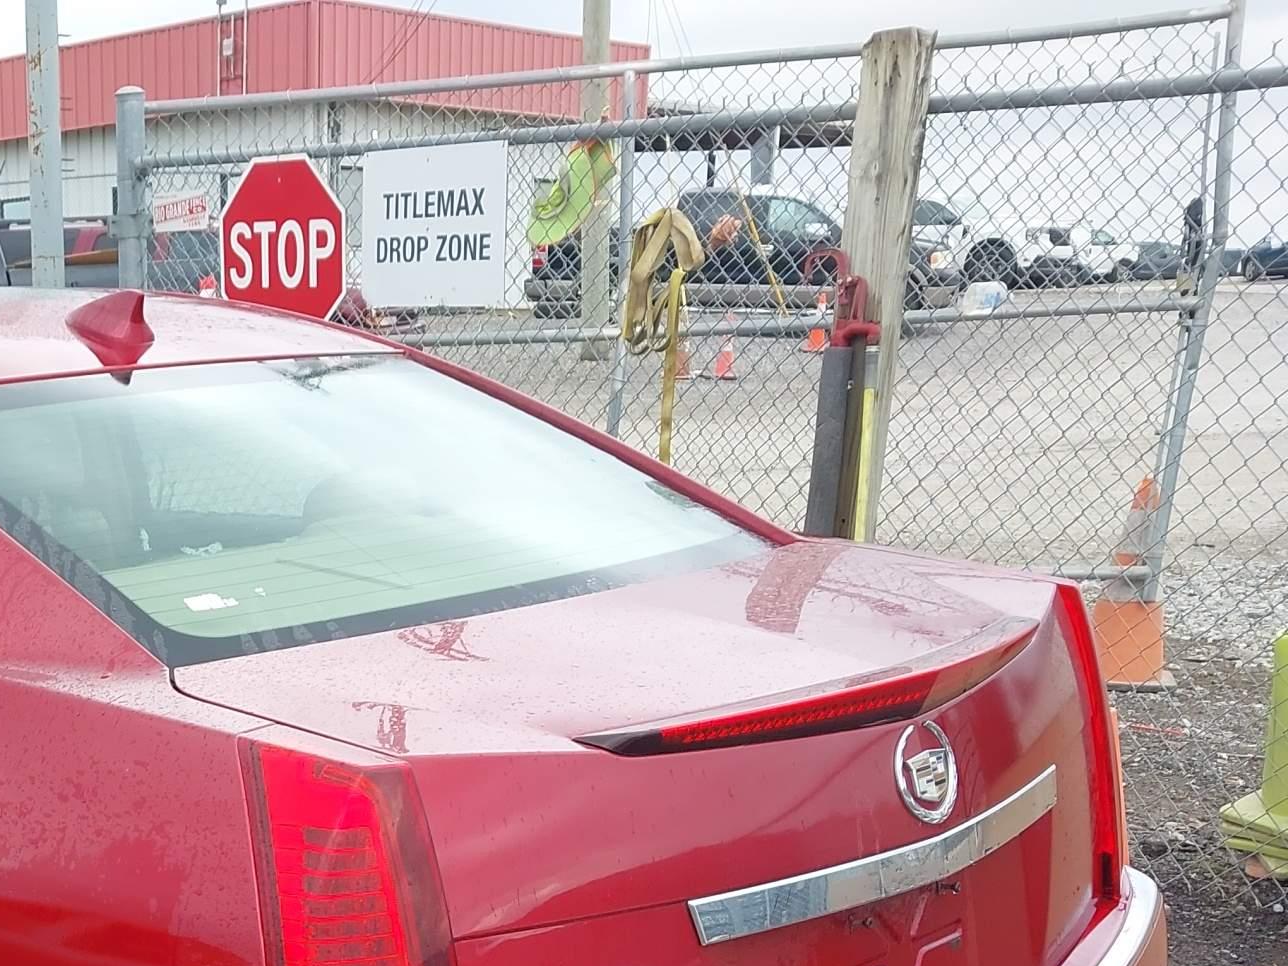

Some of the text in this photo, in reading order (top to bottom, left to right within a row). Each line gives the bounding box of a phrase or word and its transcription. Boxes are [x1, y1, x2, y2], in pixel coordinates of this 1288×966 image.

[383, 187, 486, 220] TITLEMAX
[229, 217, 337, 290] STOP
[376, 233, 492, 264] DROP ZONE
